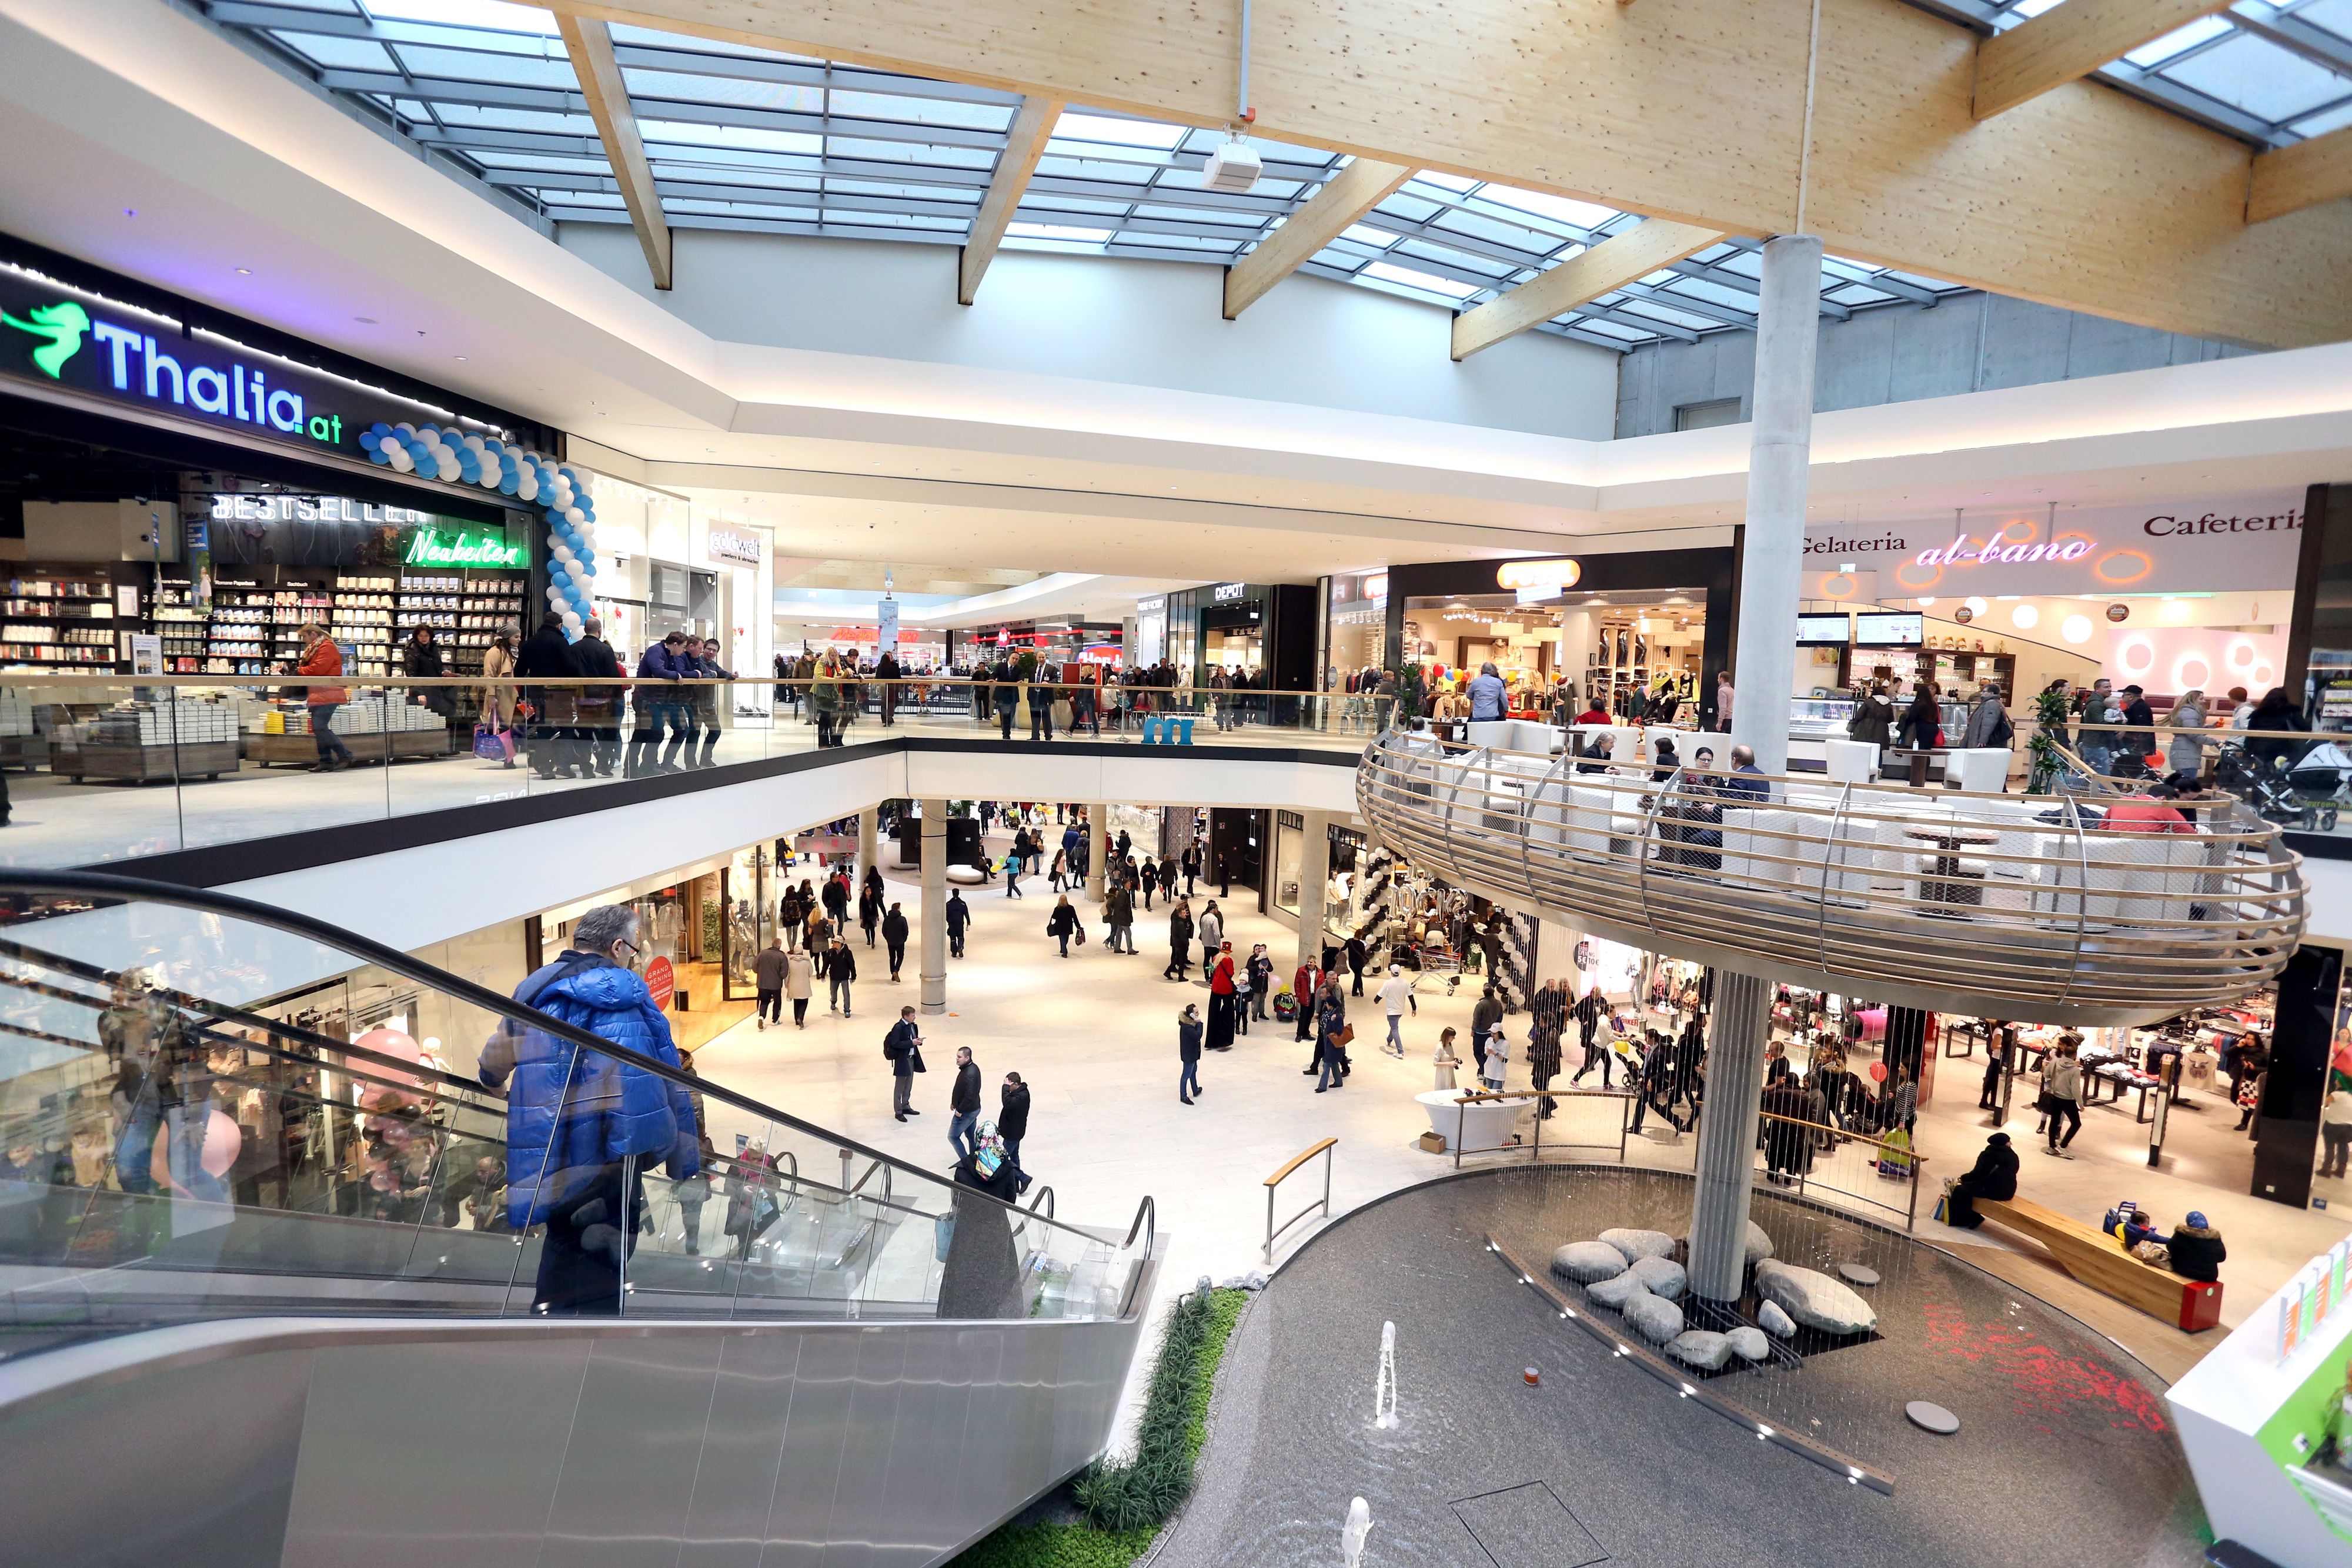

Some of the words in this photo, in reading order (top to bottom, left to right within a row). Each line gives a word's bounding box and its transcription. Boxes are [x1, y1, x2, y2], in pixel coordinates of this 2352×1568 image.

[406, 530, 519, 564] Neuheiten
[711, 531, 760, 556] goldwelt
[1916, 532, 2098, 566] al-bano
[1215, 583, 1245, 600] DEPOT
[833, 628, 918, 642] Mediaarkt
[648, 965, 669, 979] GRAND
[2187, 1021, 2194, 1029] 6
